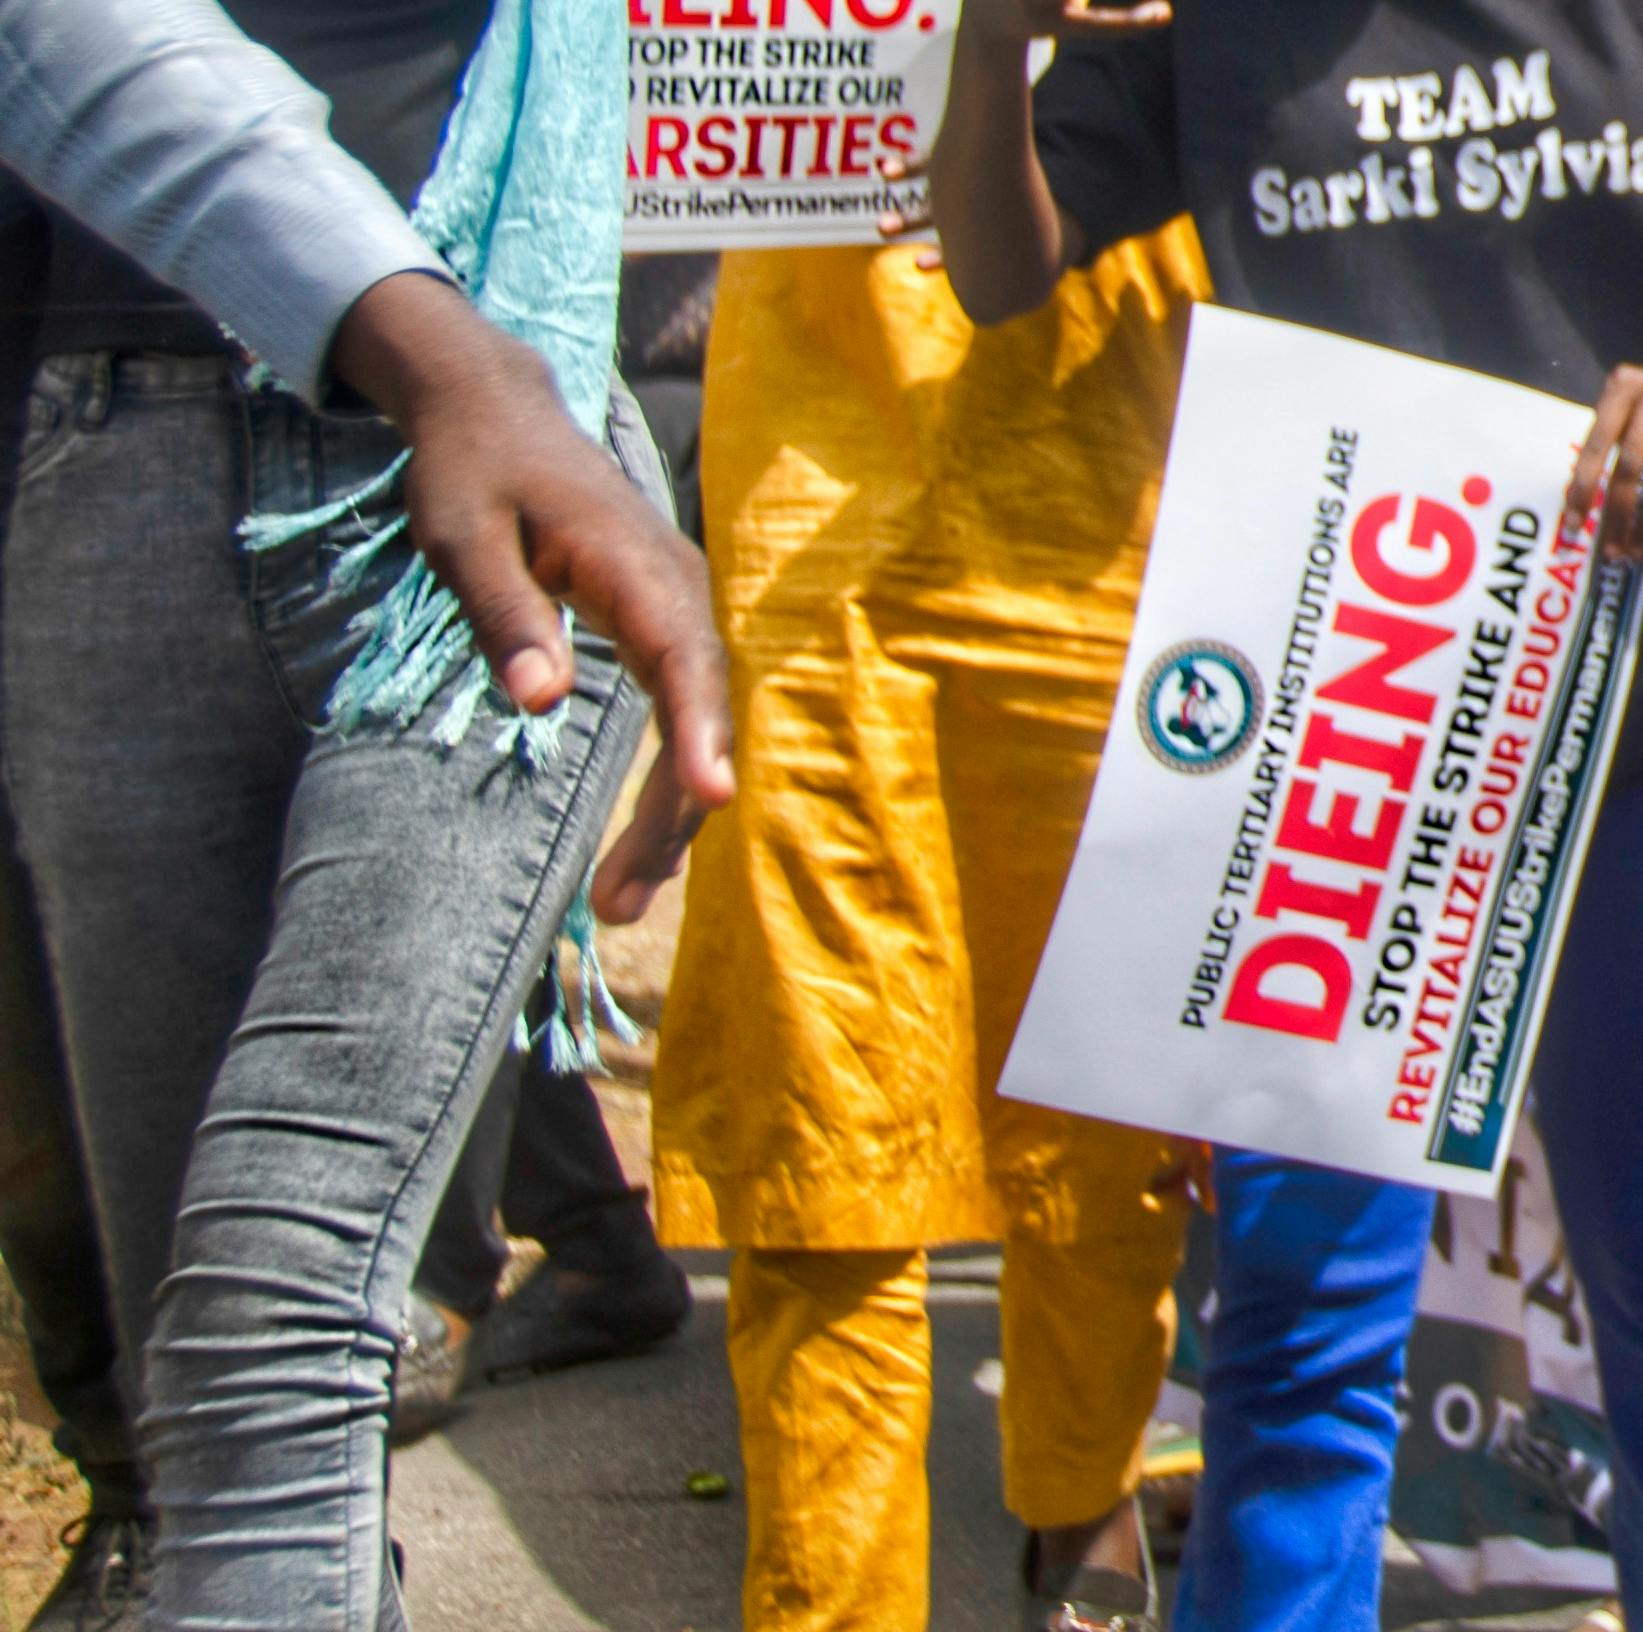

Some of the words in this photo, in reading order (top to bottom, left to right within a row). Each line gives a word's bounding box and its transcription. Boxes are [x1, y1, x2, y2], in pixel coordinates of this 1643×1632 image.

[626, 114, 917, 180] RSITIES
[628, 36, 689, 68] TOP
[699, 36, 759, 68] THE
[763, 37, 876, 69] STRIKE
[646, 76, 829, 106] REVITALIZE
[837, 78, 905, 106] OUR
[1251, 145, 1441, 237] Sarki
[1345, 48, 1558, 143] TEAM
[1181, 905, 1241, 1030] PUBLIC
[1219, 736, 1288, 898] TERTIARY
[1268, 495, 1346, 738] INSTITUTIONS
[1323, 424, 1359, 494] ARE
[1219, 474, 1493, 1045] DIEING.
[1362, 901, 1423, 1034] STOP
[1400, 803, 1458, 894] THE
[1432, 617, 1513, 797] STRIKE
[1485, 505, 1541, 617] AND
[1387, 844, 1495, 1126] REVITALIZE
[1469, 730, 1533, 837] OUR
[1505, 480, 1604, 722] EDUCAT
[1448, 556, 1634, 1137] #EndASUUStrikePermanentl
